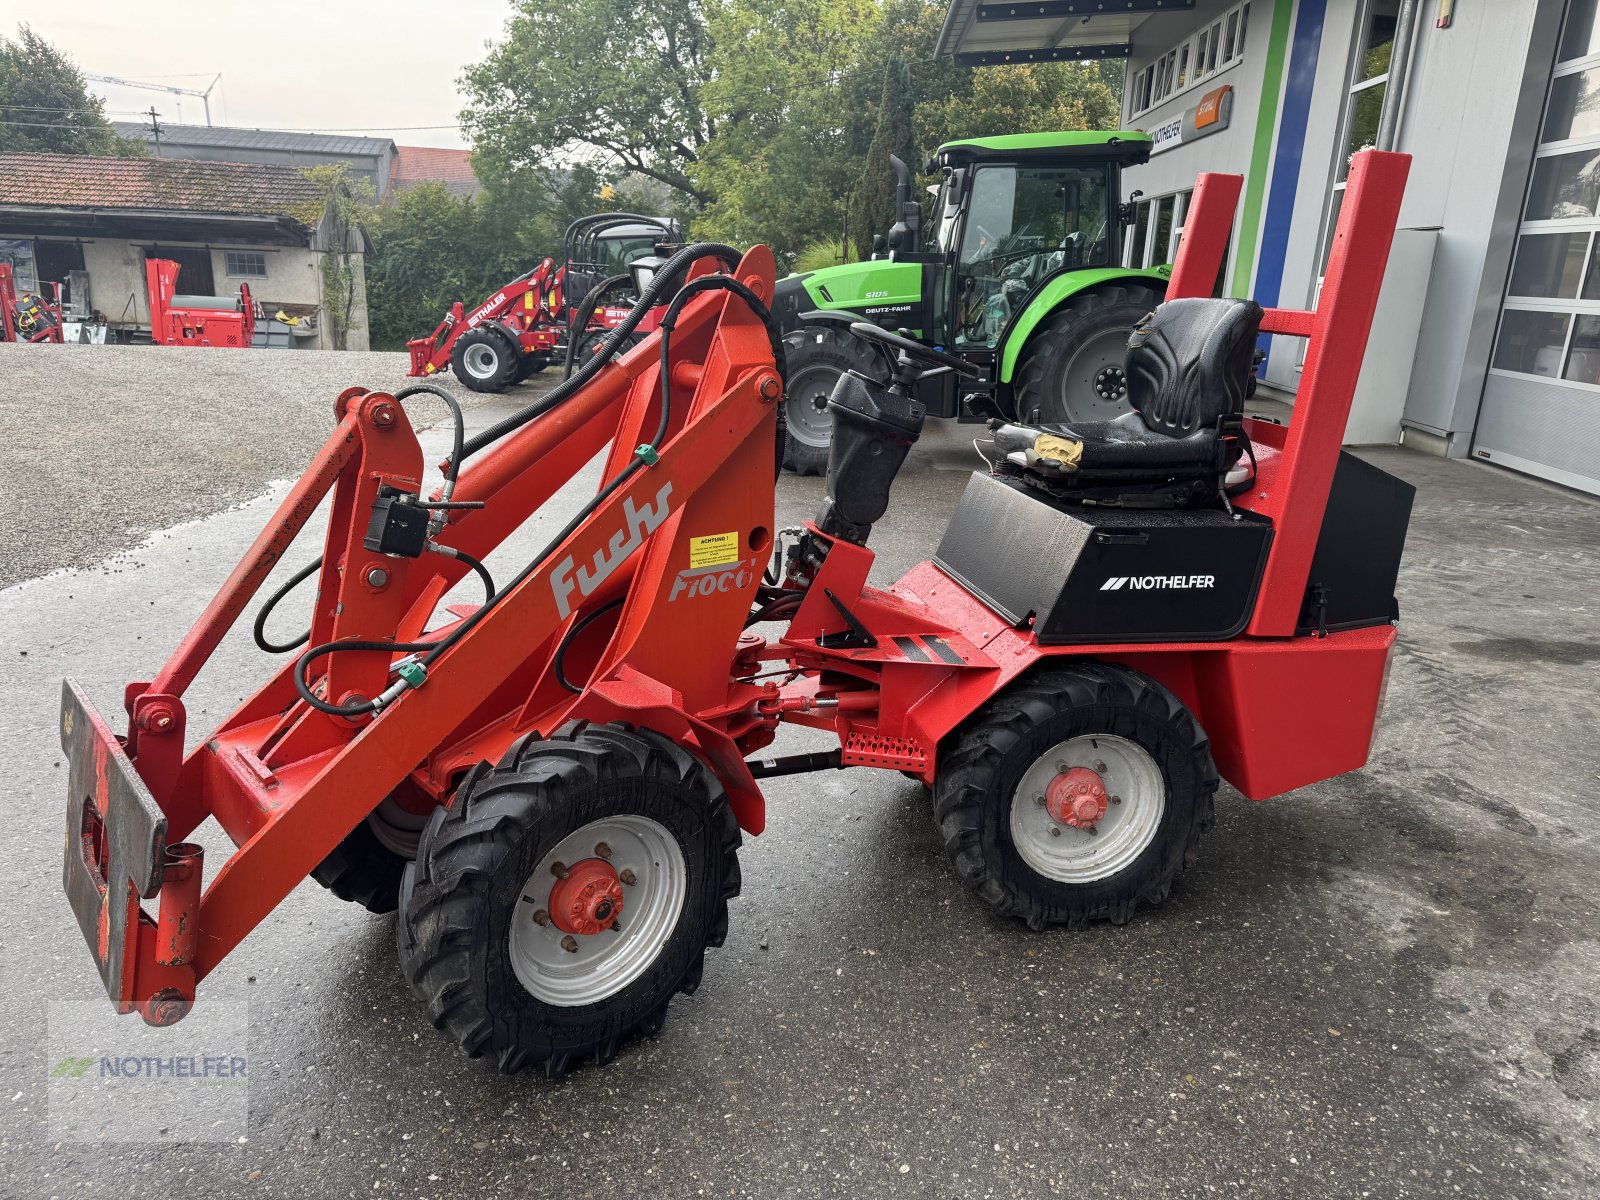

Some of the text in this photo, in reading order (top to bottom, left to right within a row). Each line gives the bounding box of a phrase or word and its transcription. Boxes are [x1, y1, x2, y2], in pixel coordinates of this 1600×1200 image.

[1154, 119, 1182, 145] NOTHELFER
[477, 292, 507, 320] THALER
[865, 305, 912, 314] DEUTZ-FAHR
[700, 536, 726, 545] ACHTUNG
[550, 480, 673, 622] Fuchs
[1130, 575, 1215, 590] NOTHELFER
